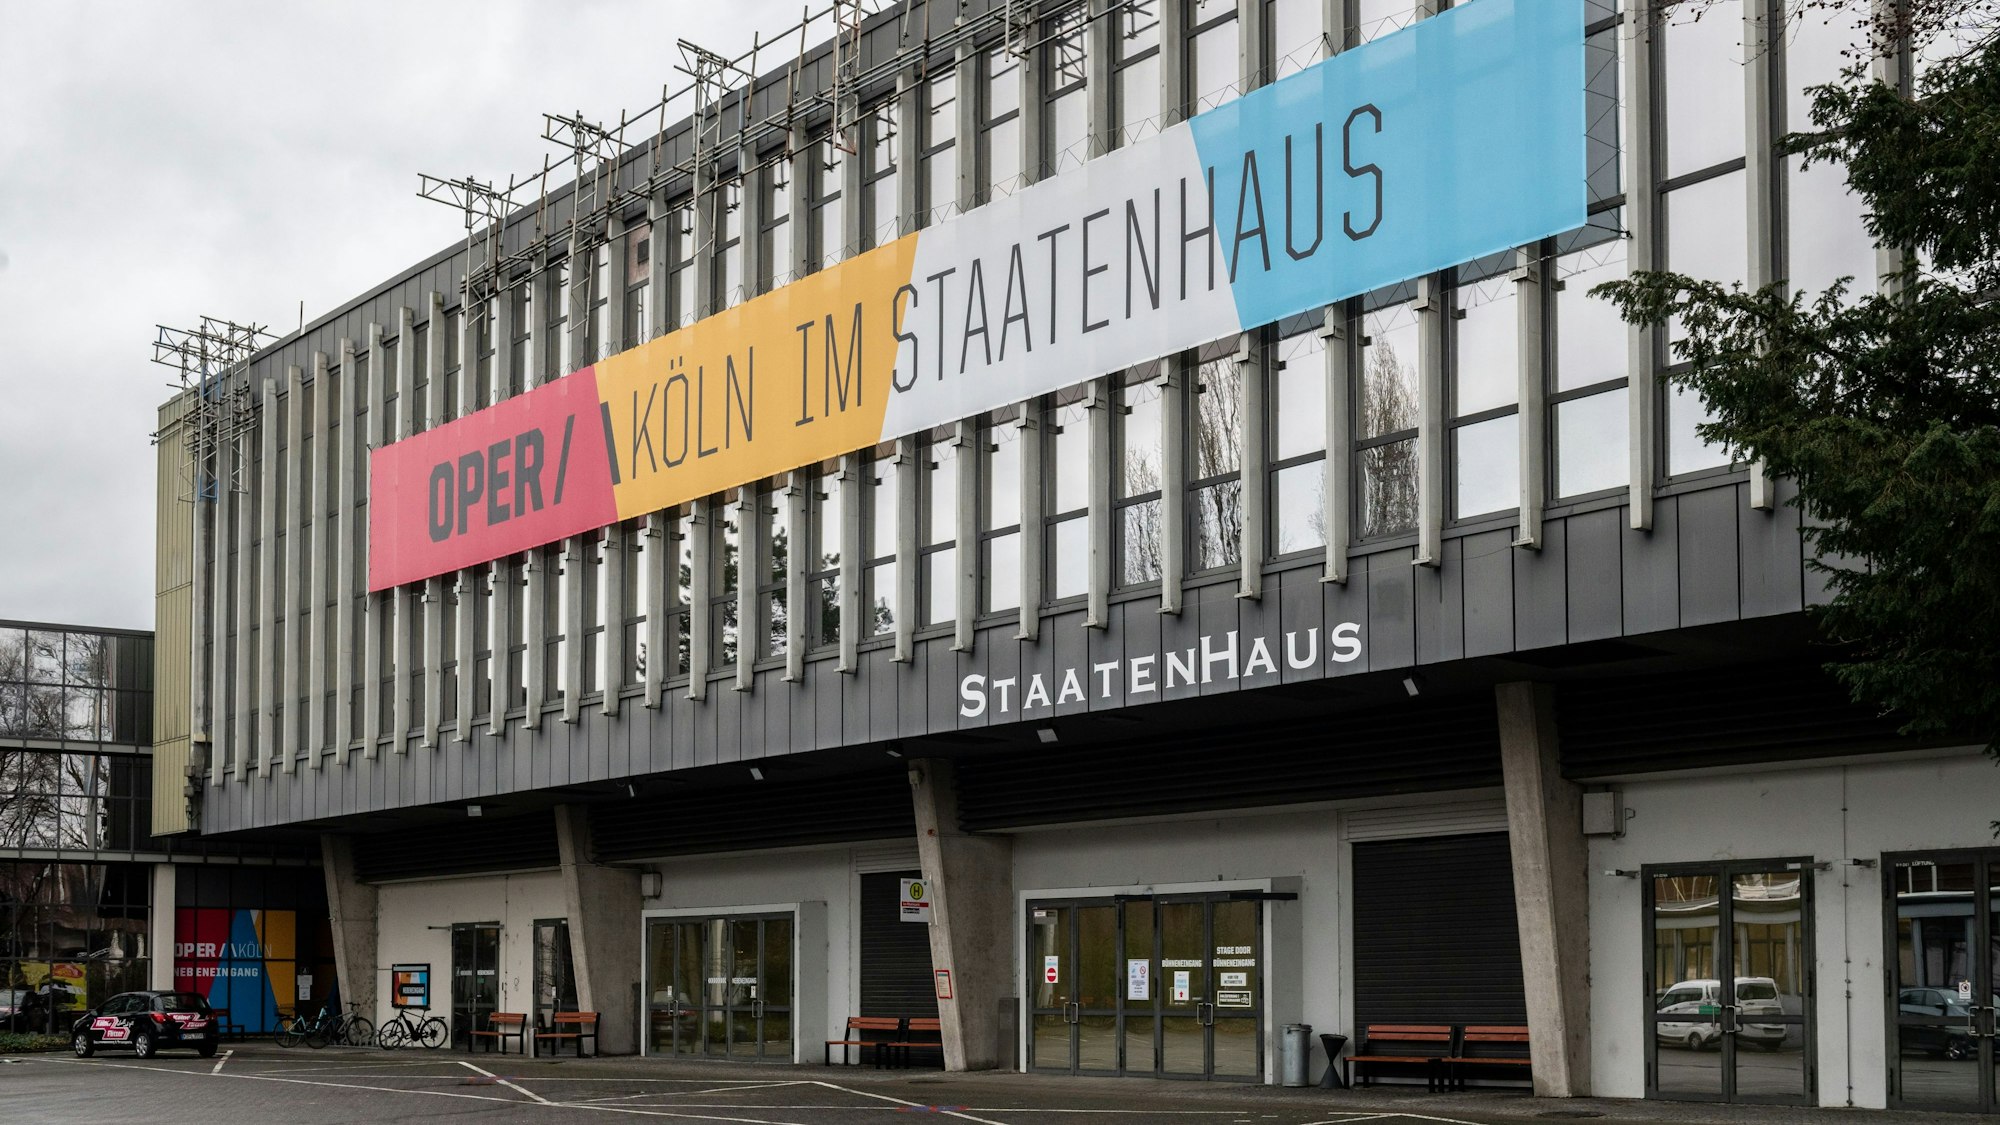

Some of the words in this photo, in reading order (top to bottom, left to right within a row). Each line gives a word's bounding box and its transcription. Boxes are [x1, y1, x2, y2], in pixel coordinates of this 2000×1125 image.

[796, 302, 862, 427] IM
[892, 103, 1383, 394] STAATENHAUS
[1216, 946, 1235, 955] STAGE
[1235, 946, 1251, 955] DOOR
[1161, 958, 1202, 967] BÜHNENEINGANG
[1212, 958, 1256, 967] BÜHNENEINGANG
